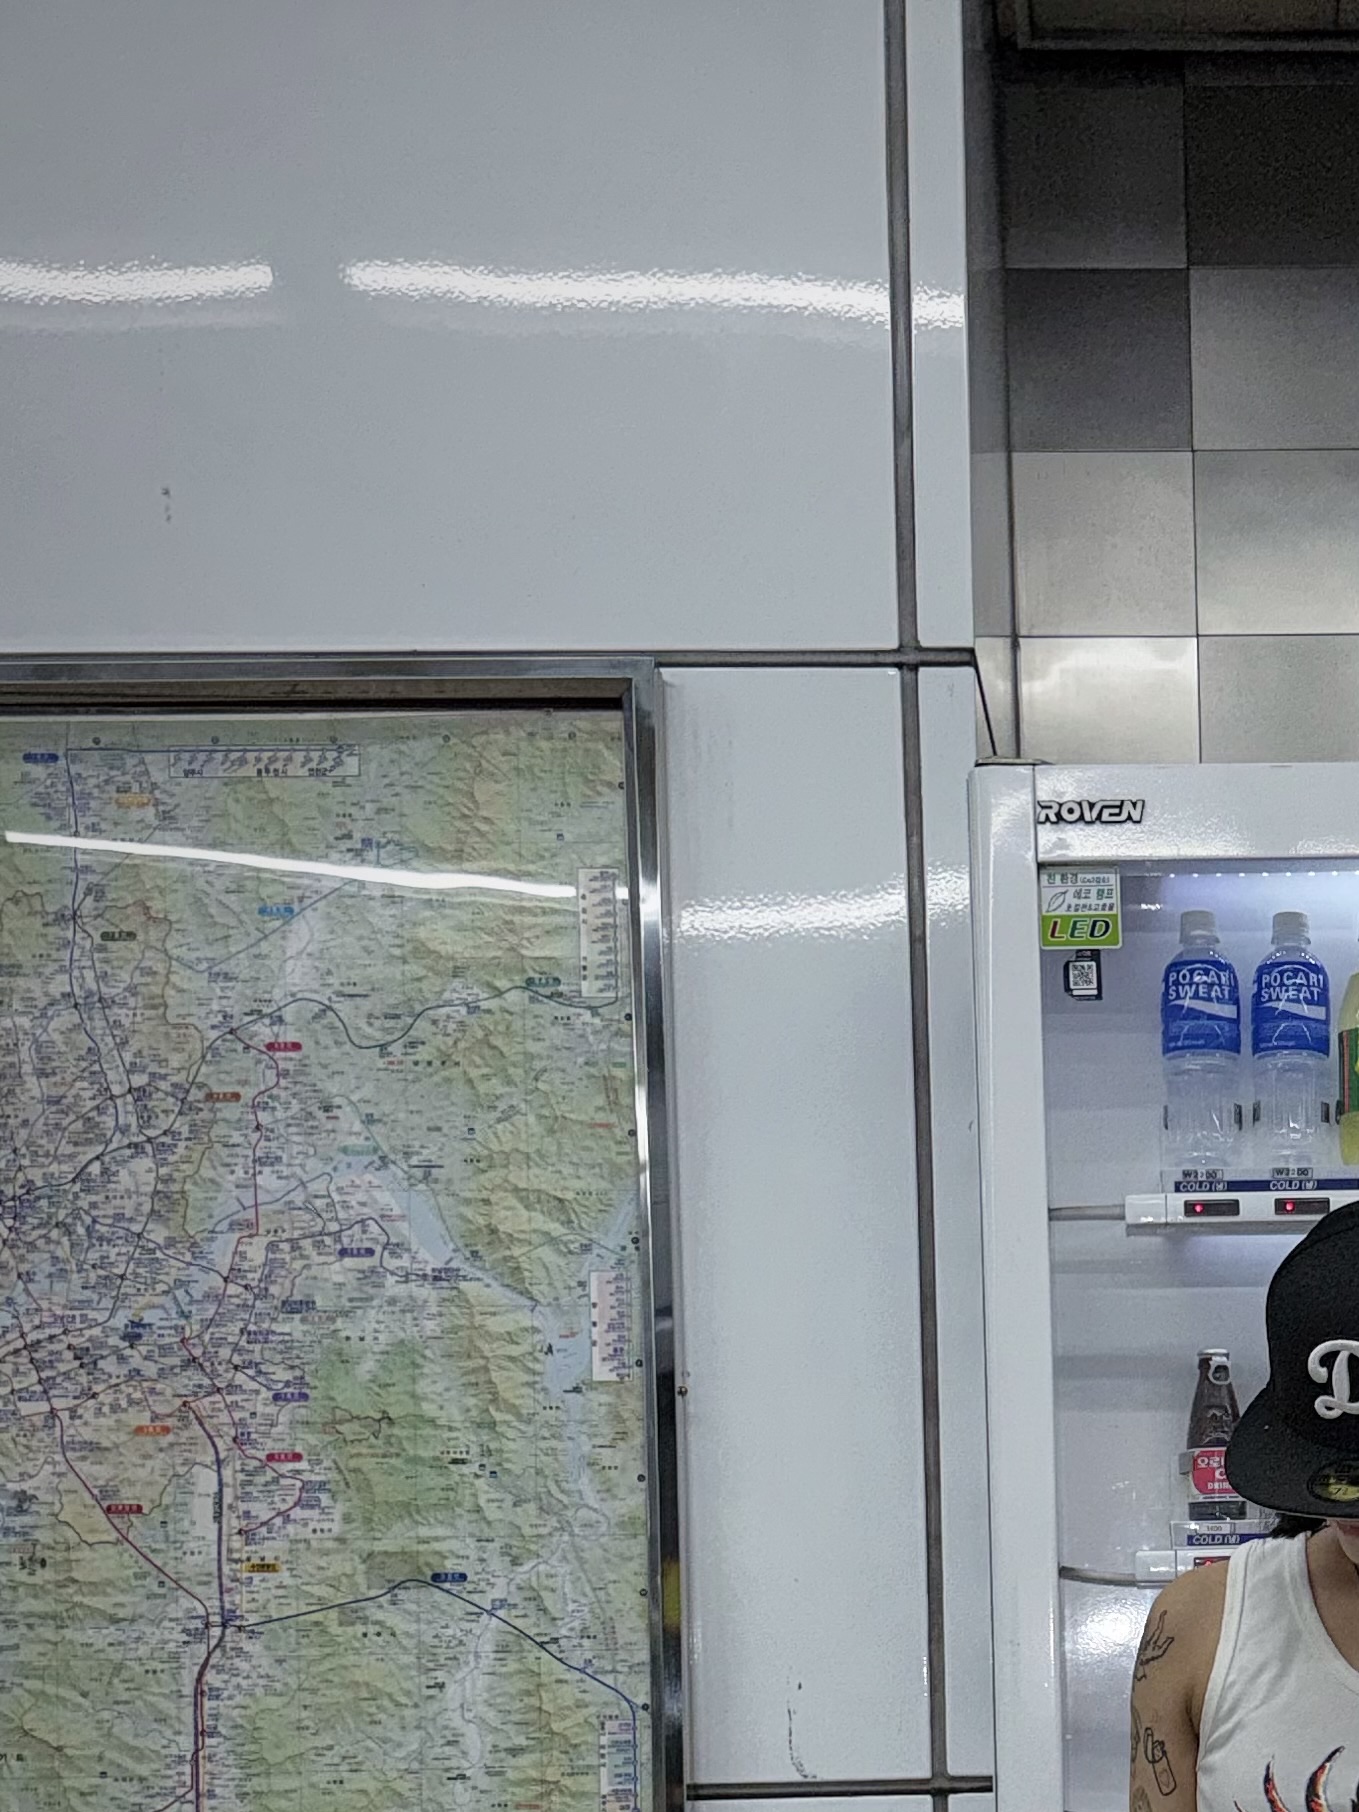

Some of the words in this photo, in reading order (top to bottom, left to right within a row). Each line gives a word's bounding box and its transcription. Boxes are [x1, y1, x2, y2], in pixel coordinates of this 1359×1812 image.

[1037, 799, 1145, 824] ROVEN
[1048, 918, 1112, 940] LED
[1169, 969, 1235, 987] POCARI
[1262, 971, 1324, 988] POCARI
[1168, 985, 1232, 1000] SWEAT
[1261, 987, 1322, 1002] SWEAT
[1180, 1181, 1208, 1191] COLD
[1270, 1180, 1299, 1190] COLD
[1207, 1481, 1233, 1491] DRIN
[1194, 1534, 1222, 1544] COLD
